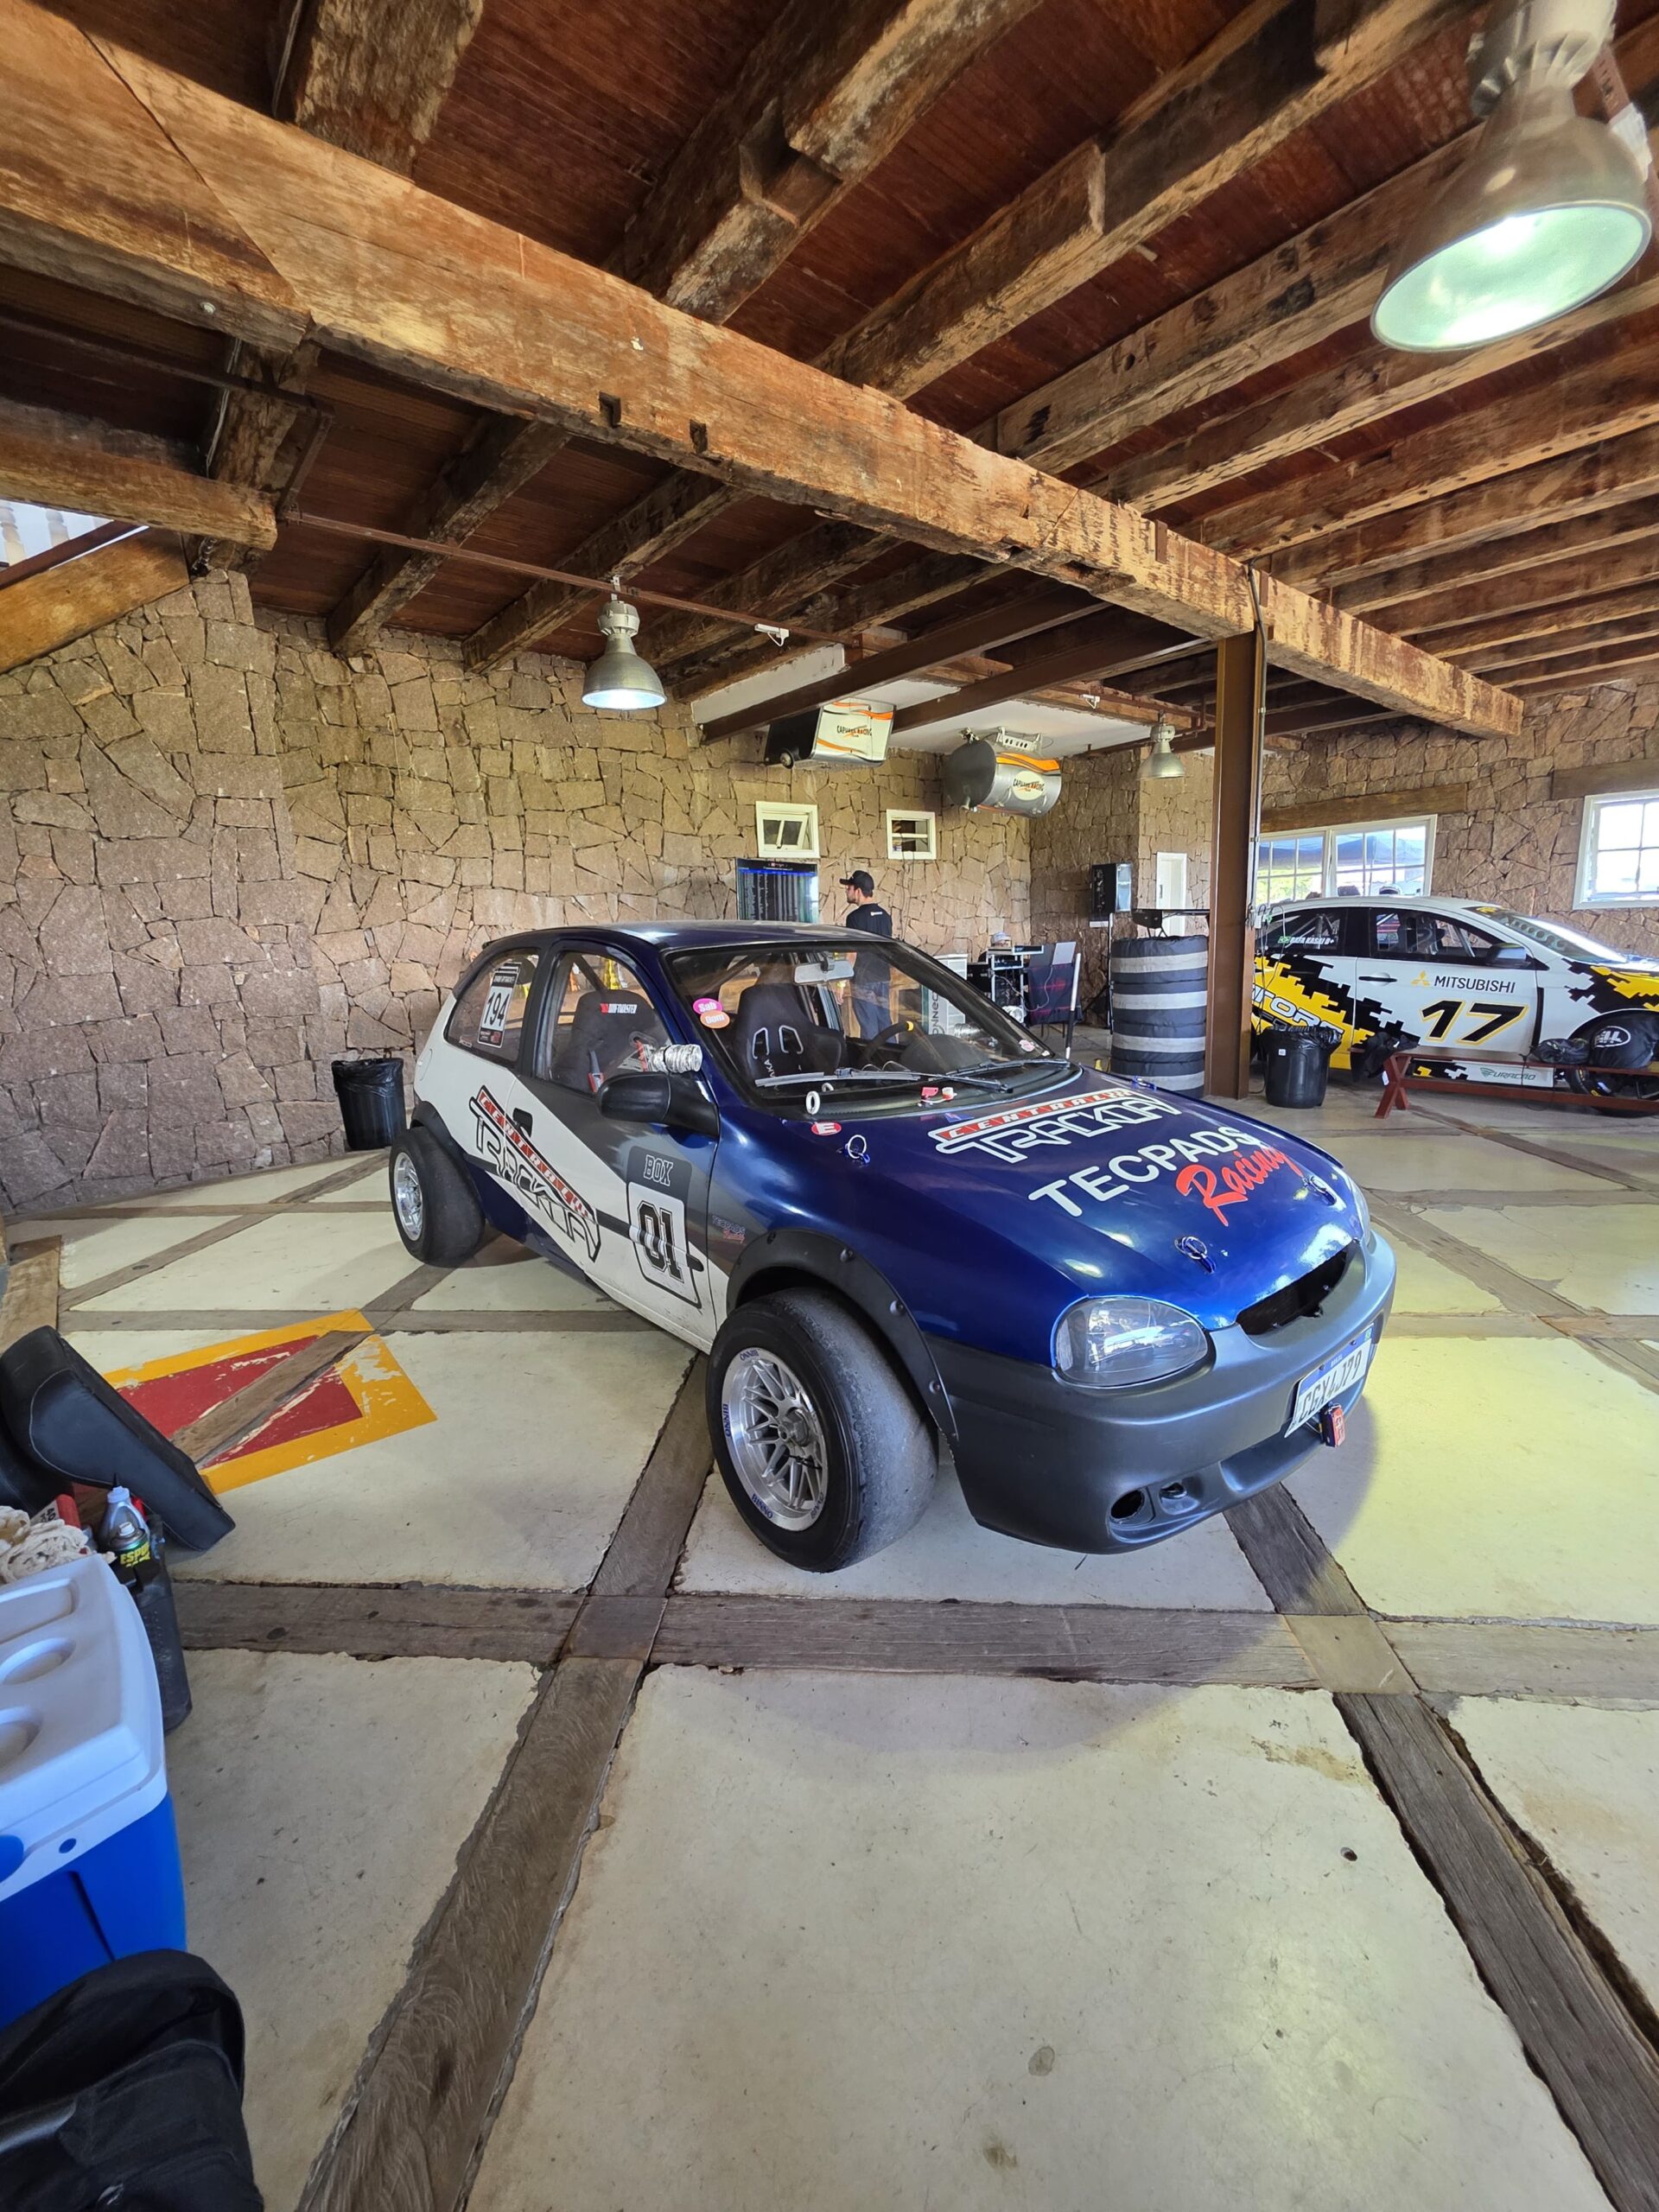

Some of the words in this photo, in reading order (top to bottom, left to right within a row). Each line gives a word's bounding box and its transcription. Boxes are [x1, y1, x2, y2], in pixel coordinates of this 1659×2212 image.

[698, 1001, 716, 1012] Sab
[1434, 976, 1516, 993] MITSUBISHI
[484, 992, 510, 1027] 194
[1421, 1000, 1528, 1044] 17
[949, 1092, 1110, 1138] CENTRAL
[480, 1095, 575, 1202] CENTRAL
[644, 1154, 673, 1186] BOX
[1028, 1126, 1266, 1217] TECPADS
[1175, 1147, 1305, 1227] Racing
[637, 1200, 684, 1283] 01
[752, 1493, 773, 1518] BINNO
